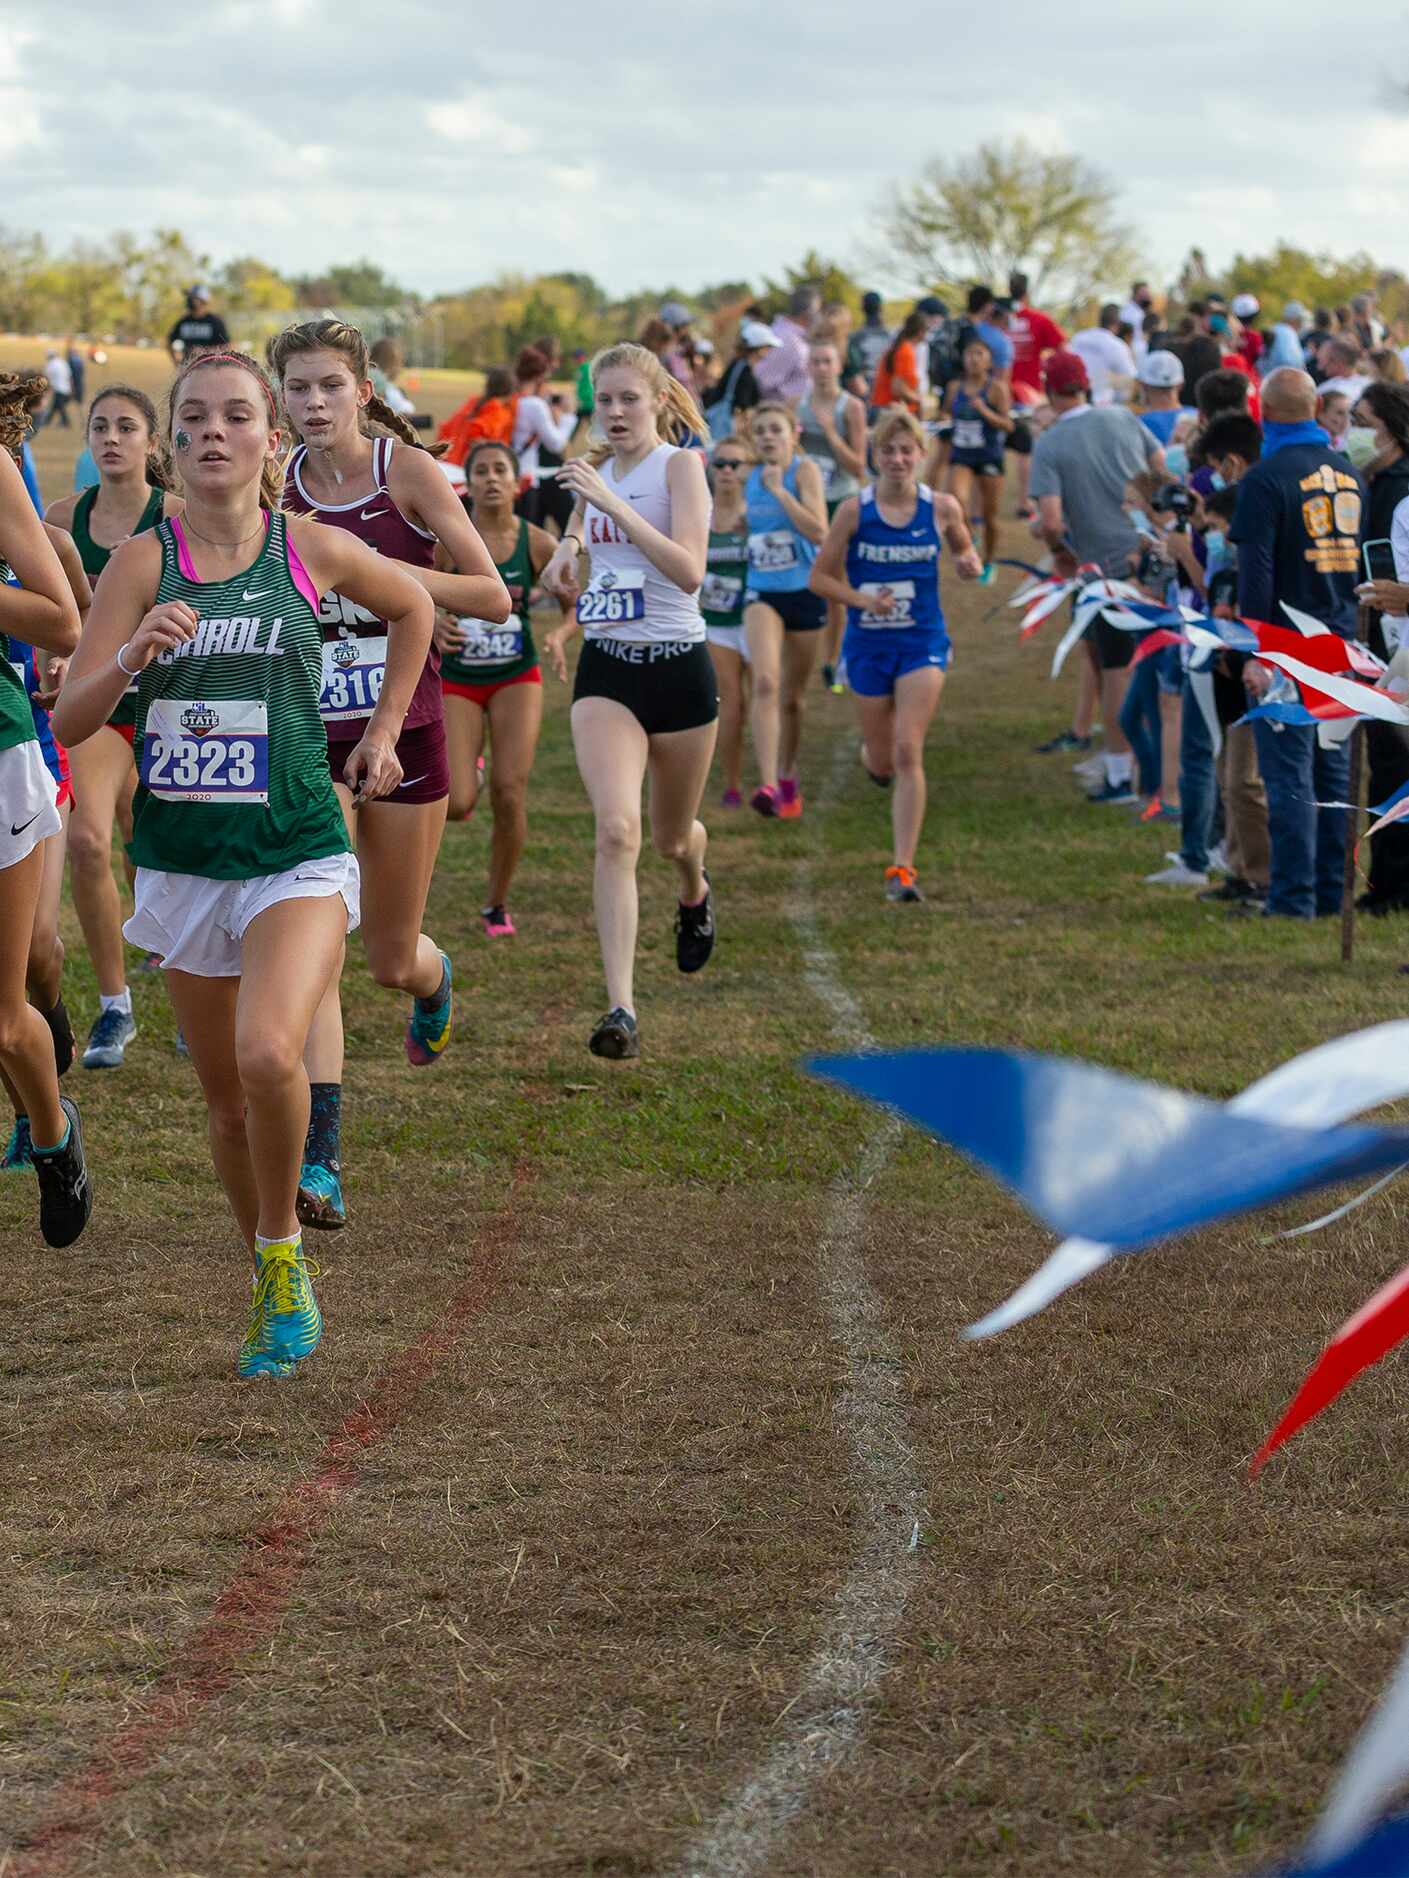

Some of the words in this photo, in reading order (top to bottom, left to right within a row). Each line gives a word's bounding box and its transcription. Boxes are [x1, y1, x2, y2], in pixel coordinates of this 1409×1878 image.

[591, 517, 632, 544] KA
[578, 591, 635, 622] 2261
[464, 633, 518, 658] 2342
[596, 639, 643, 664] NIKE
[181, 715, 220, 726] STATE
[148, 740, 256, 787] 2323
